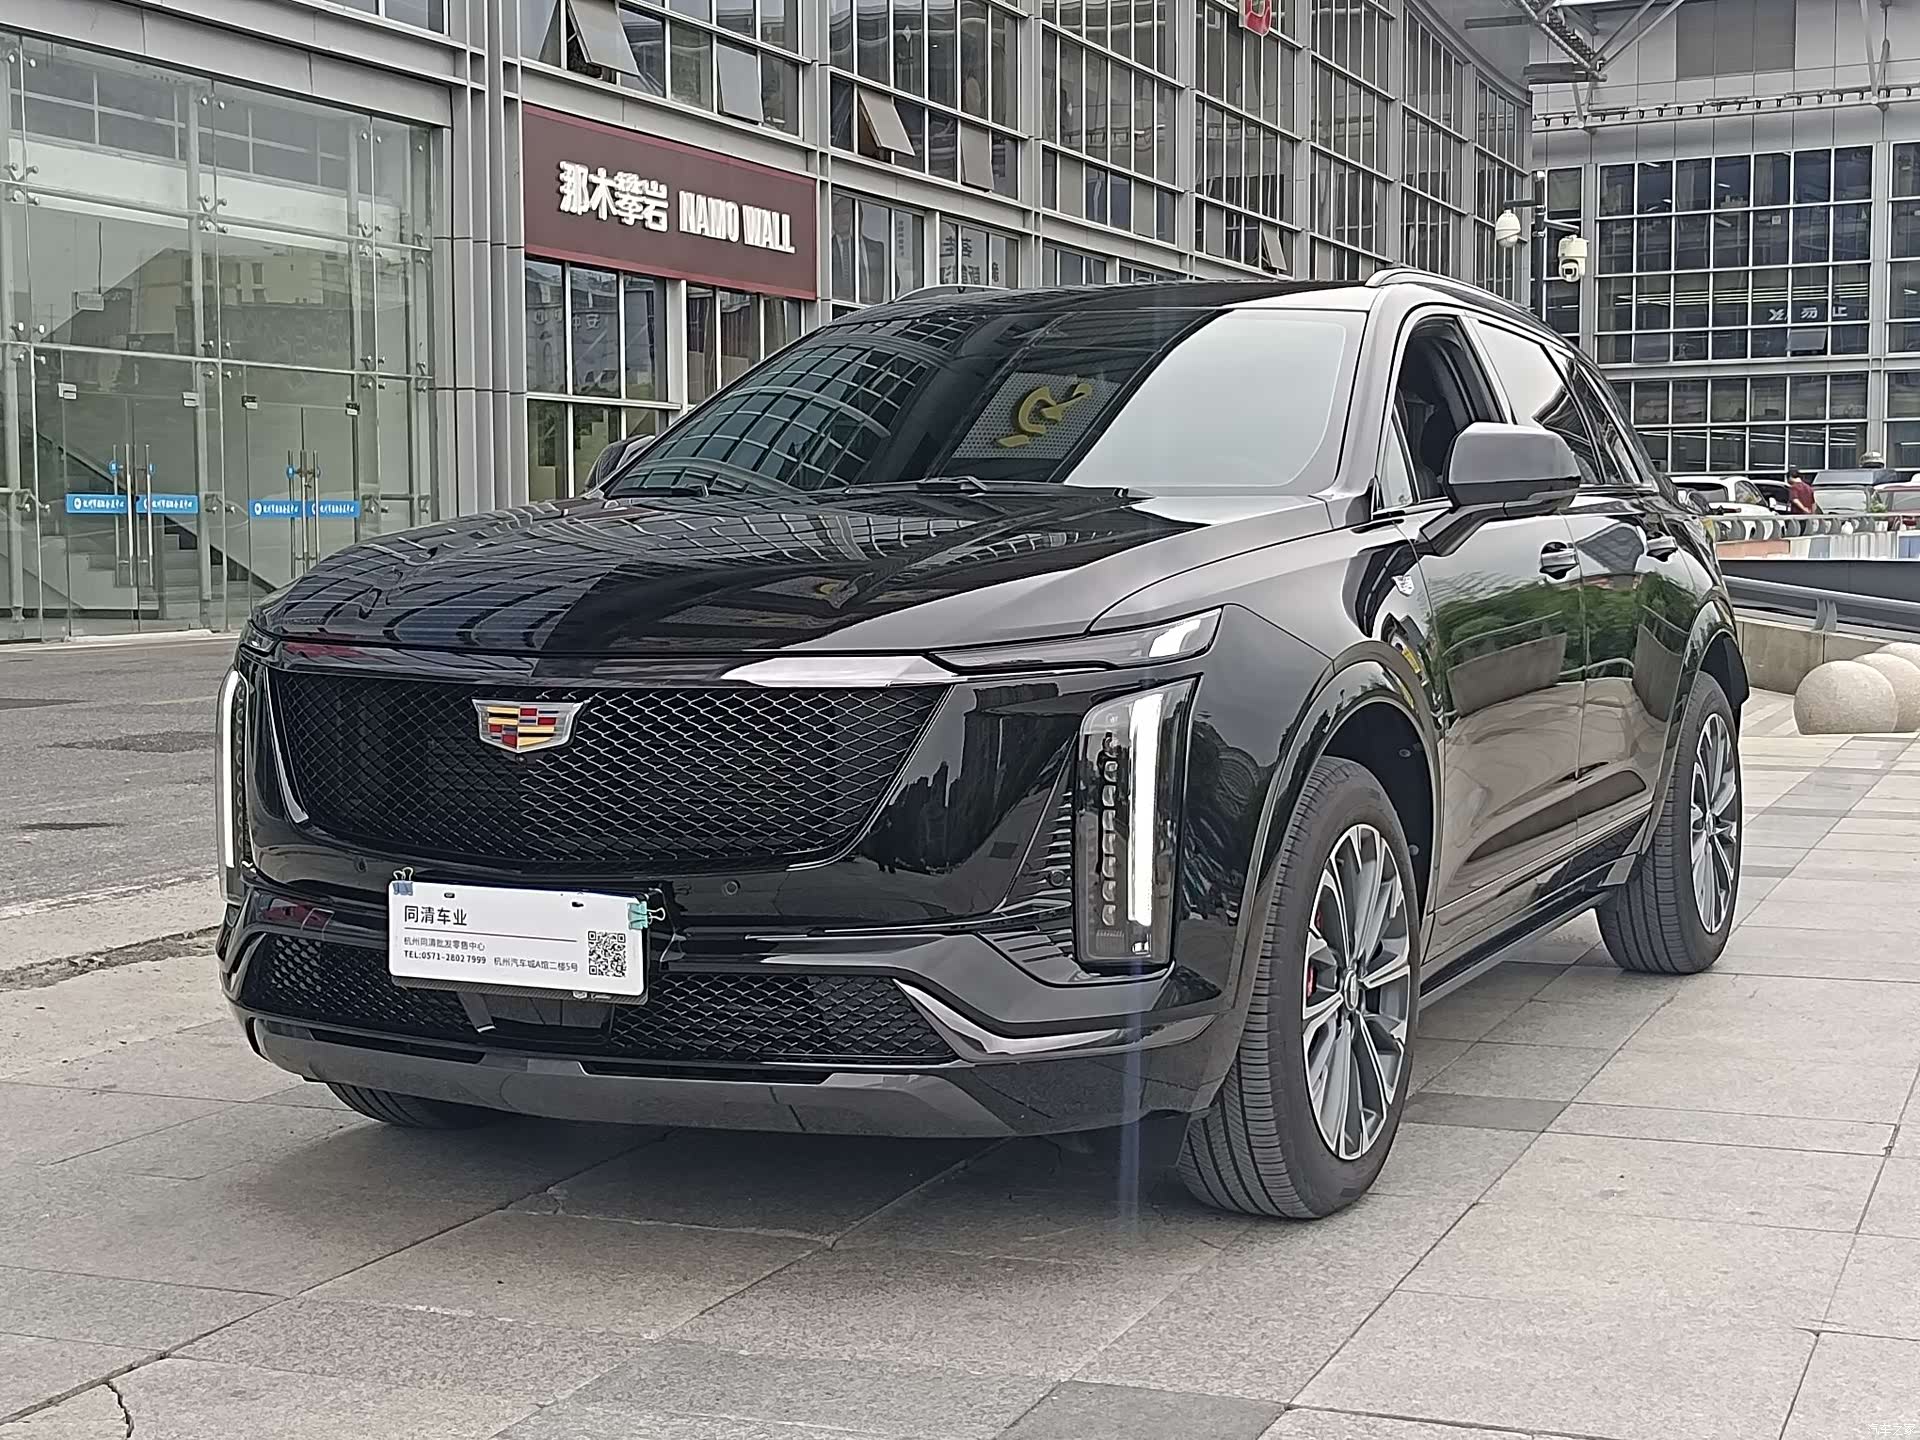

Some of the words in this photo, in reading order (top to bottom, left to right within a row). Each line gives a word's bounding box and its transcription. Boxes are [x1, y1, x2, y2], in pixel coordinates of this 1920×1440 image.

[559, 160, 669, 233] 那木攀岩
[679, 190, 740, 243] NAMO
[742, 204, 796, 254] WALL
[404, 905, 468, 926] 同清车业
